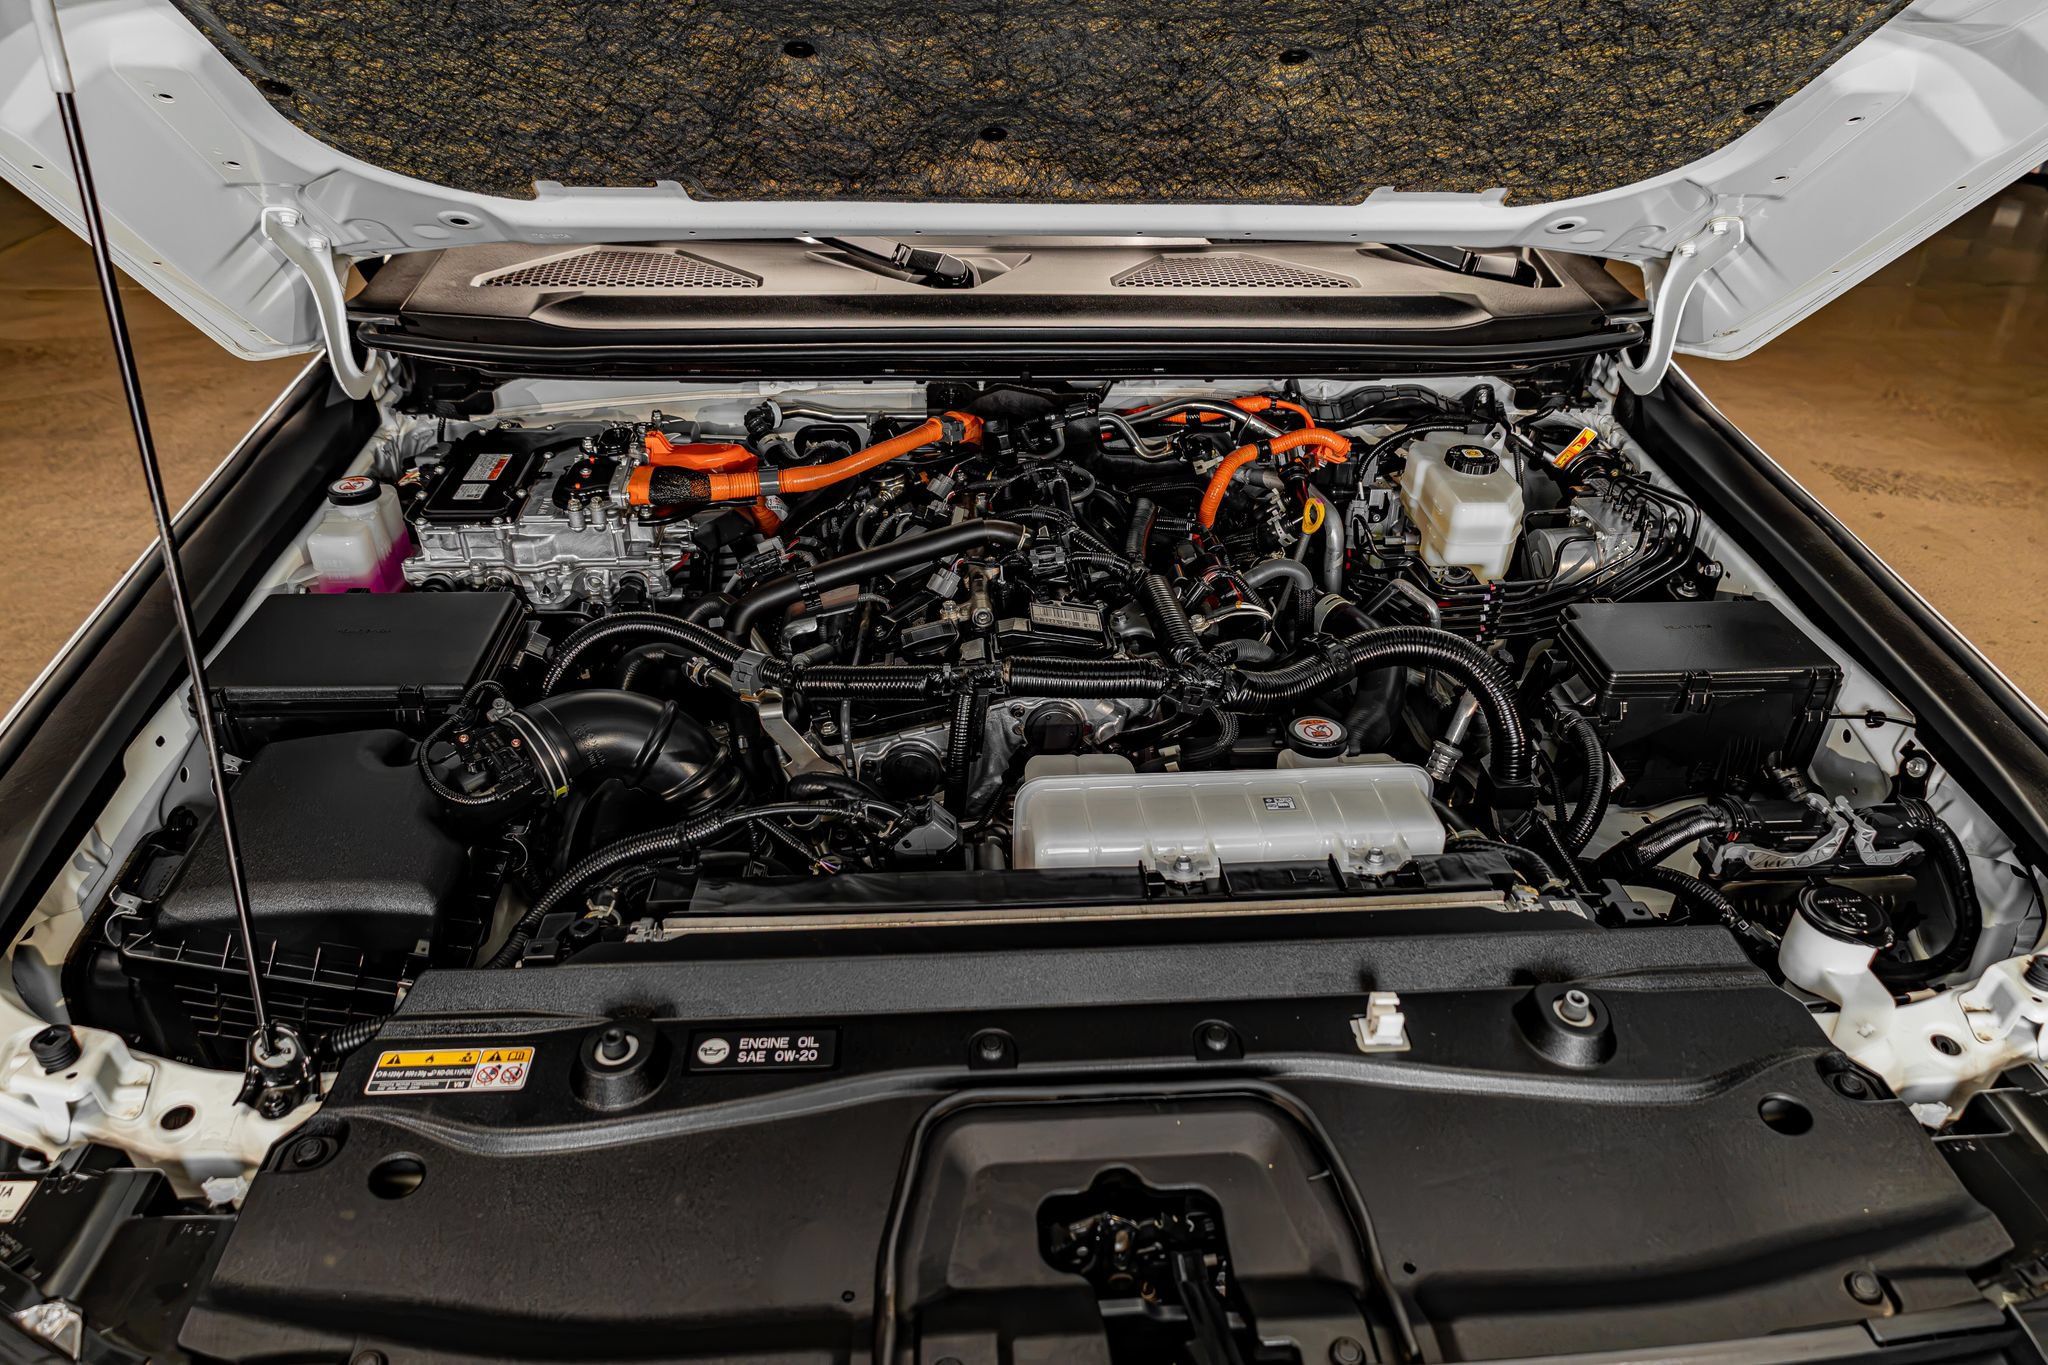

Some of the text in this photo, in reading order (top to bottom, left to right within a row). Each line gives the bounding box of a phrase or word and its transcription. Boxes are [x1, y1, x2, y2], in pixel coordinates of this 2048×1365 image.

[739, 1036, 819, 1049] ENGINE OIL
[737, 1050, 818, 1063] SAE 0W-20
[453, 1080, 466, 1089] VM
